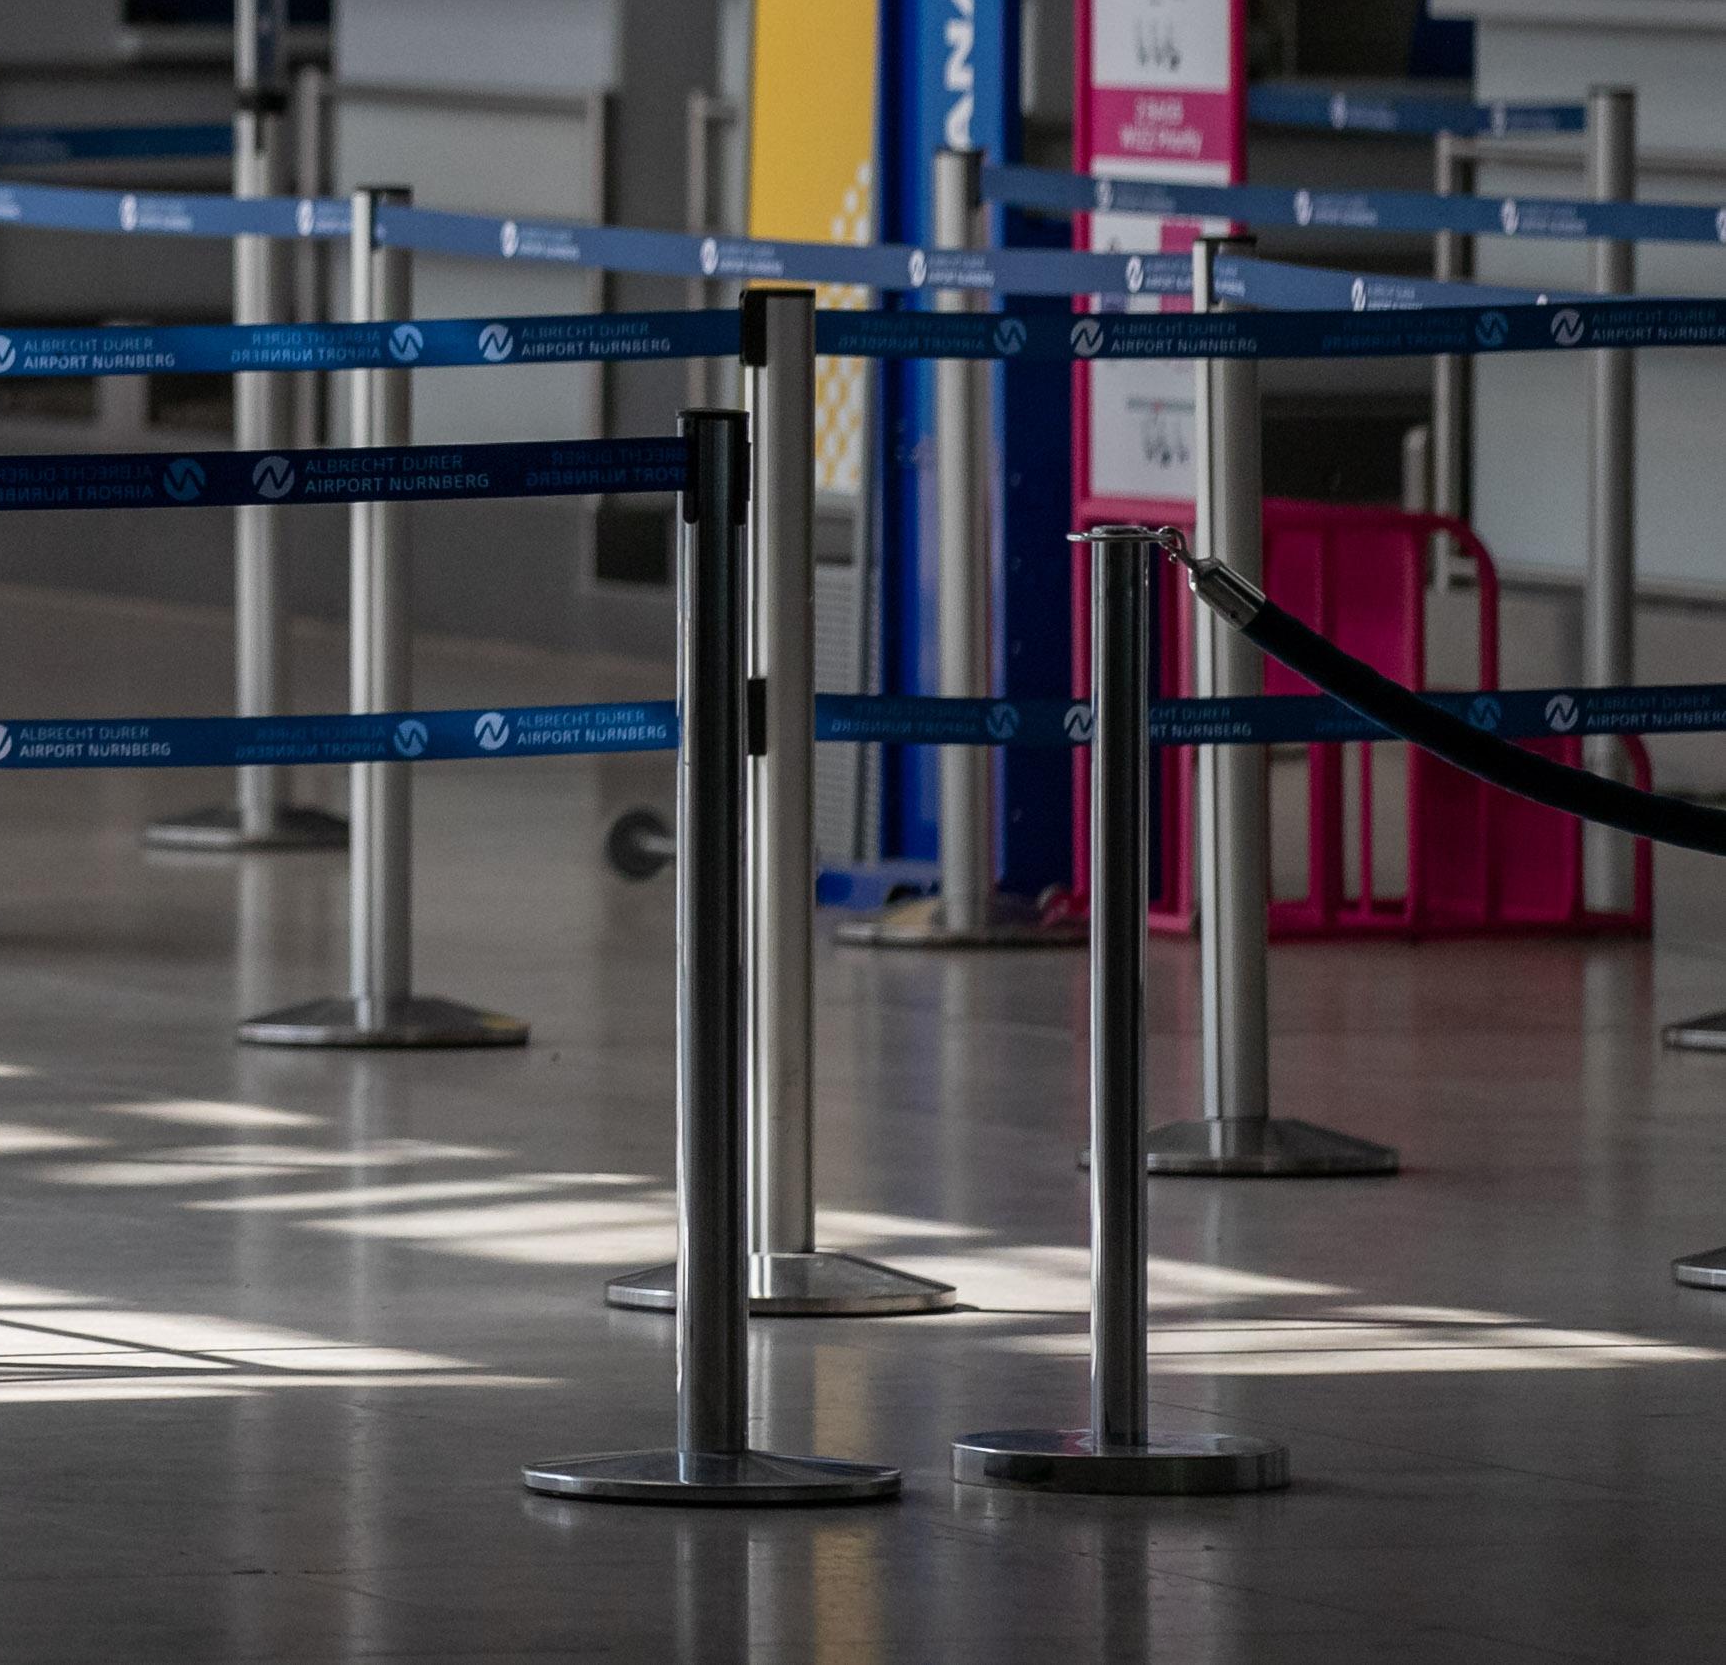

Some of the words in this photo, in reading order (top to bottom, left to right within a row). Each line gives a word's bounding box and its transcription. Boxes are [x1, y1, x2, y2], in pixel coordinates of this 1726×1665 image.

[522, 342, 584, 355] AIRPORT
[1110, 340, 1172, 353] AIRPORT
[23, 356, 87, 370] AIRPORT
[304, 457, 395, 473] ALBRECHT
[304, 477, 382, 493] AIRPORT
[516, 731, 579, 746] AIRPORT
[20, 744, 84, 757] AIRPORT
